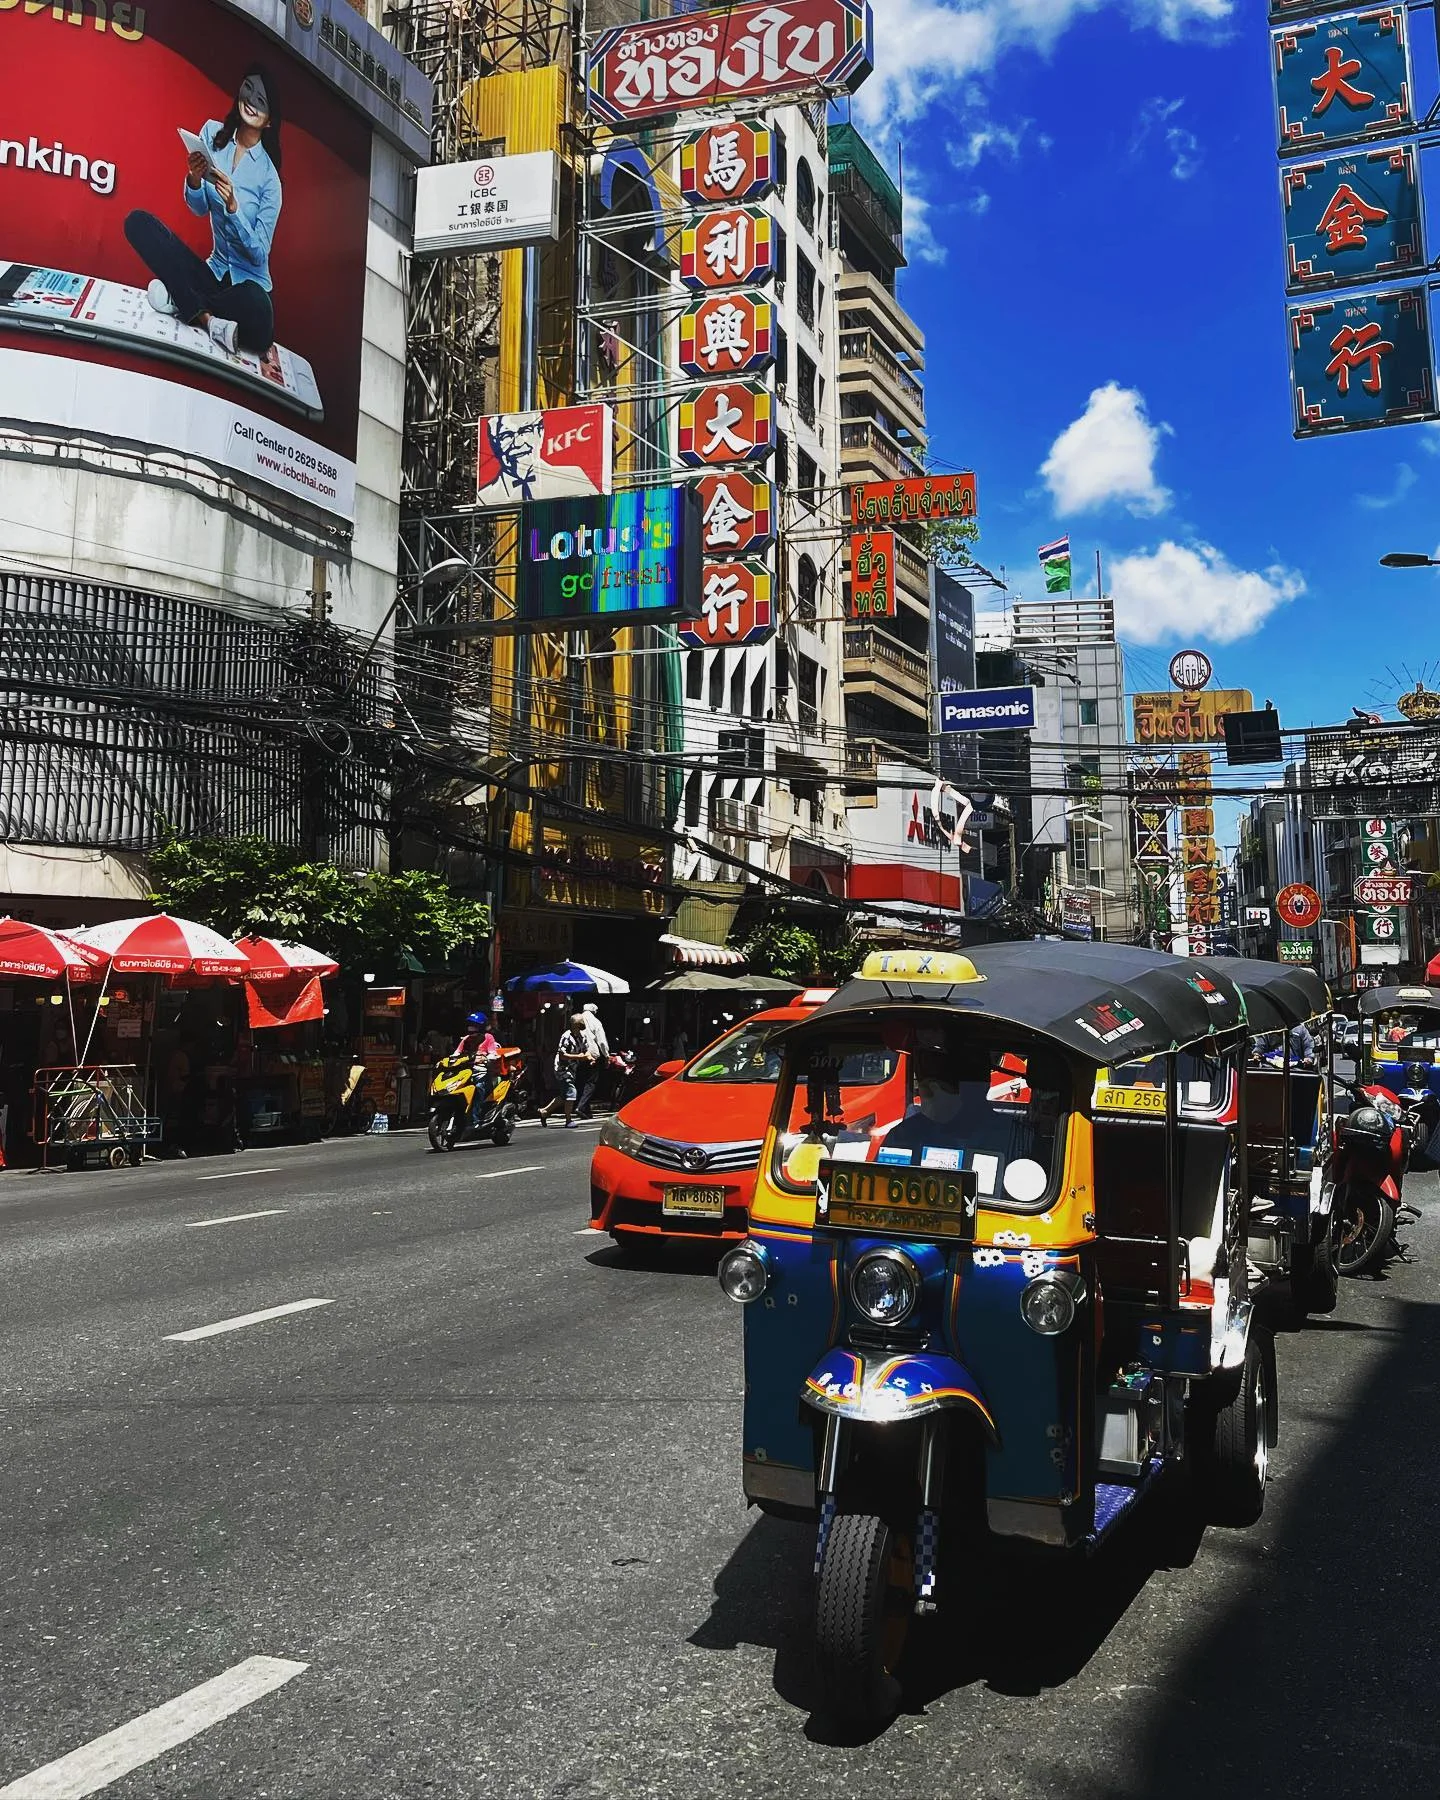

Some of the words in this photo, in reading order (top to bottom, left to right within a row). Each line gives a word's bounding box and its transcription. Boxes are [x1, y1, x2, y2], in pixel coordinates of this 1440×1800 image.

[613, 7, 836, 108] ทองใบ
[617, 23, 720, 60] ห้างทอง
[0, 136, 116, 194] nking
[457, 199, 508, 217] 工银泰国
[470, 187, 497, 199] ICBC
[234, 421, 254, 441] Call
[255, 431, 287, 456] Center
[287, 446, 294, 459] 0
[295, 450, 316, 470] 2629
[317, 460, 338, 481] 5588
[546, 422, 593, 457] KFC
[256, 452, 337, 499] www.icbcthai.com
[854, 478, 973, 520] โรงรับจำนำ
[529, 516, 673, 562] Lotus's
[560, 573, 595, 599] go
[601, 562, 673, 590] fresh
[945, 701, 1030, 721] Panasonic
[693, 1190, 720, 1204] 8066
[888, 1176, 961, 1209] 6606
